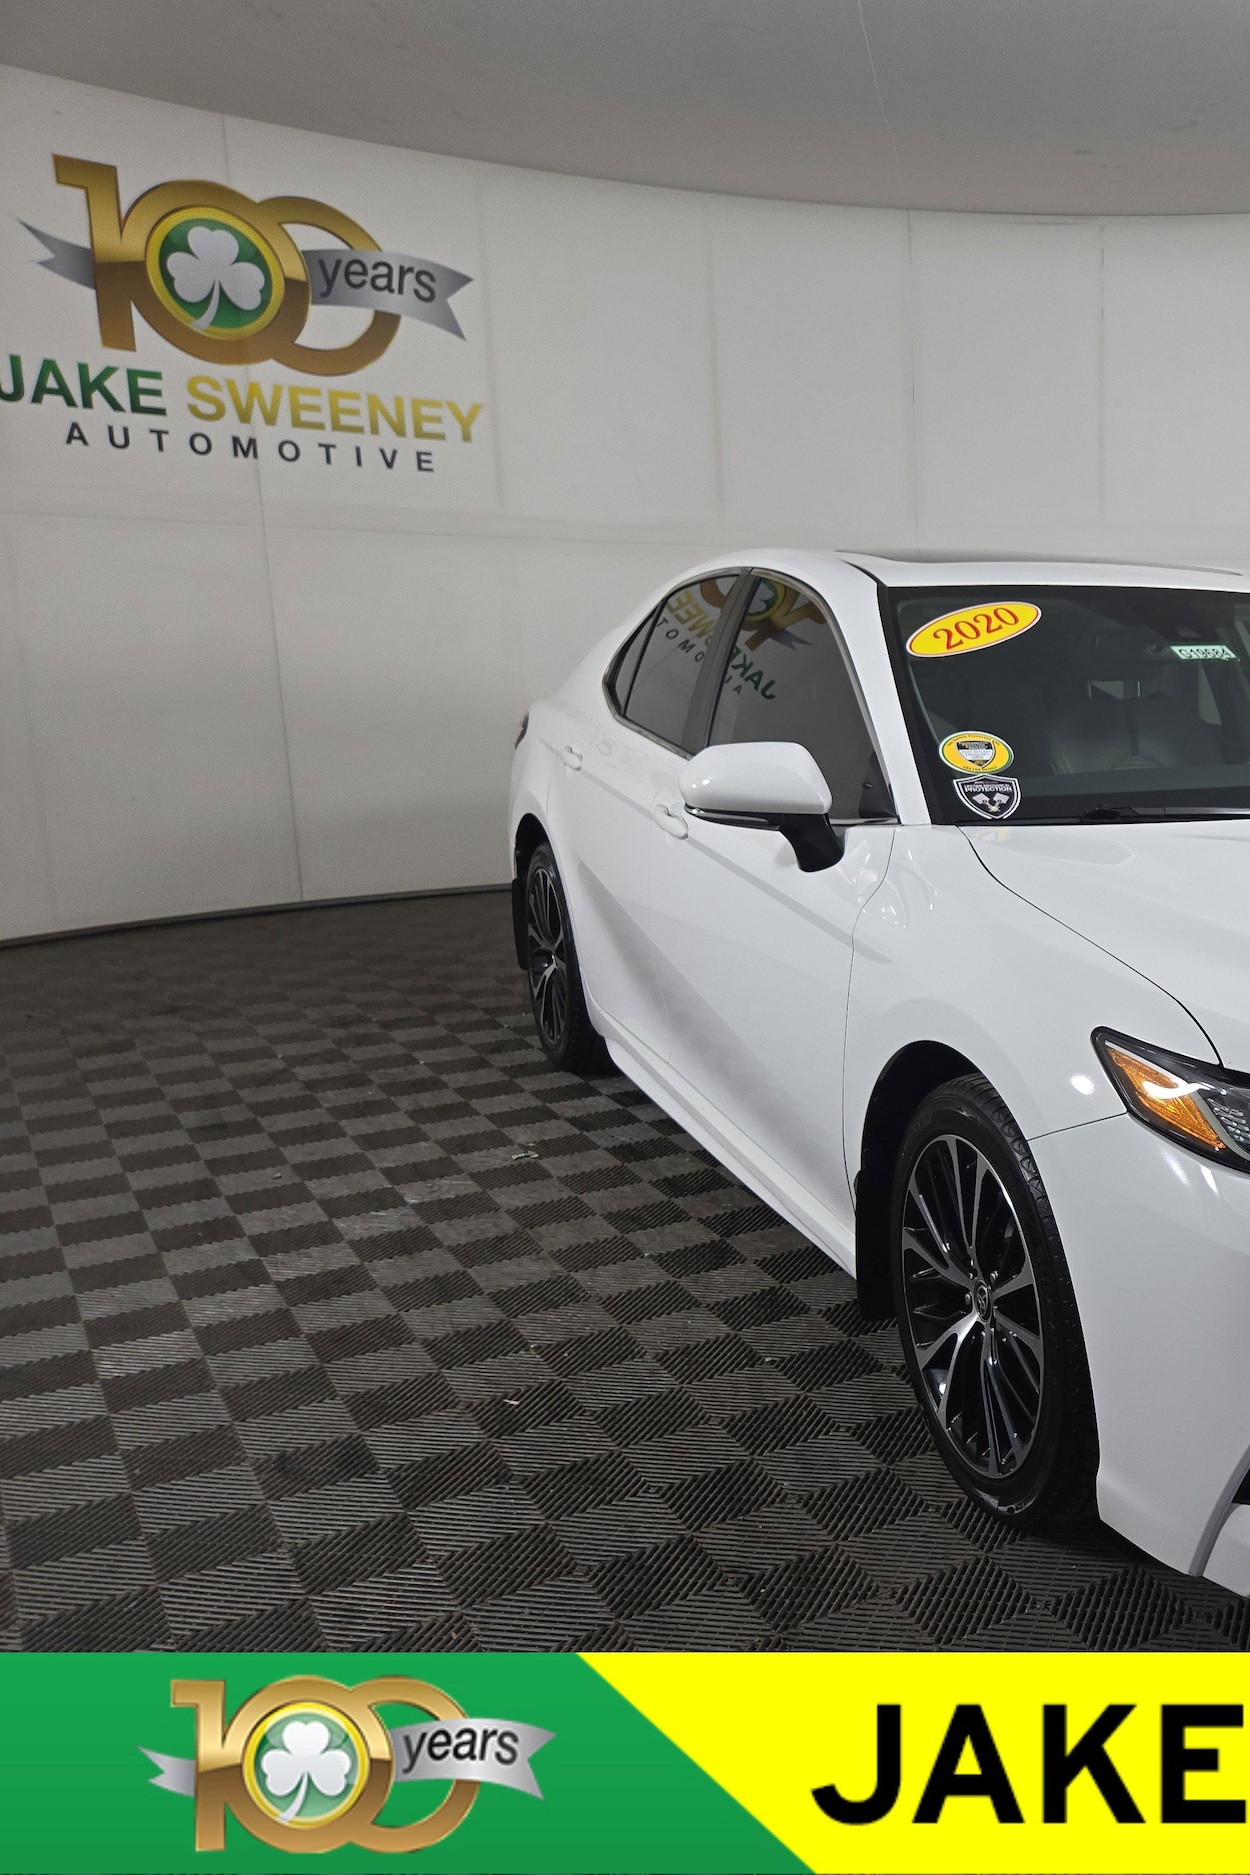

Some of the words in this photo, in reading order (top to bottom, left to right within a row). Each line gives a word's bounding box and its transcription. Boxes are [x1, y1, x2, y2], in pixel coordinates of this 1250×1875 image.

[53, 153, 402, 377] 100
[317, 256, 438, 303] years
[0, 352, 168, 416] JAKE
[185, 374, 484, 444] SWEENEY
[65, 421, 436, 472] AUTOMOTIVE
[932, 606, 1020, 650] 2020
